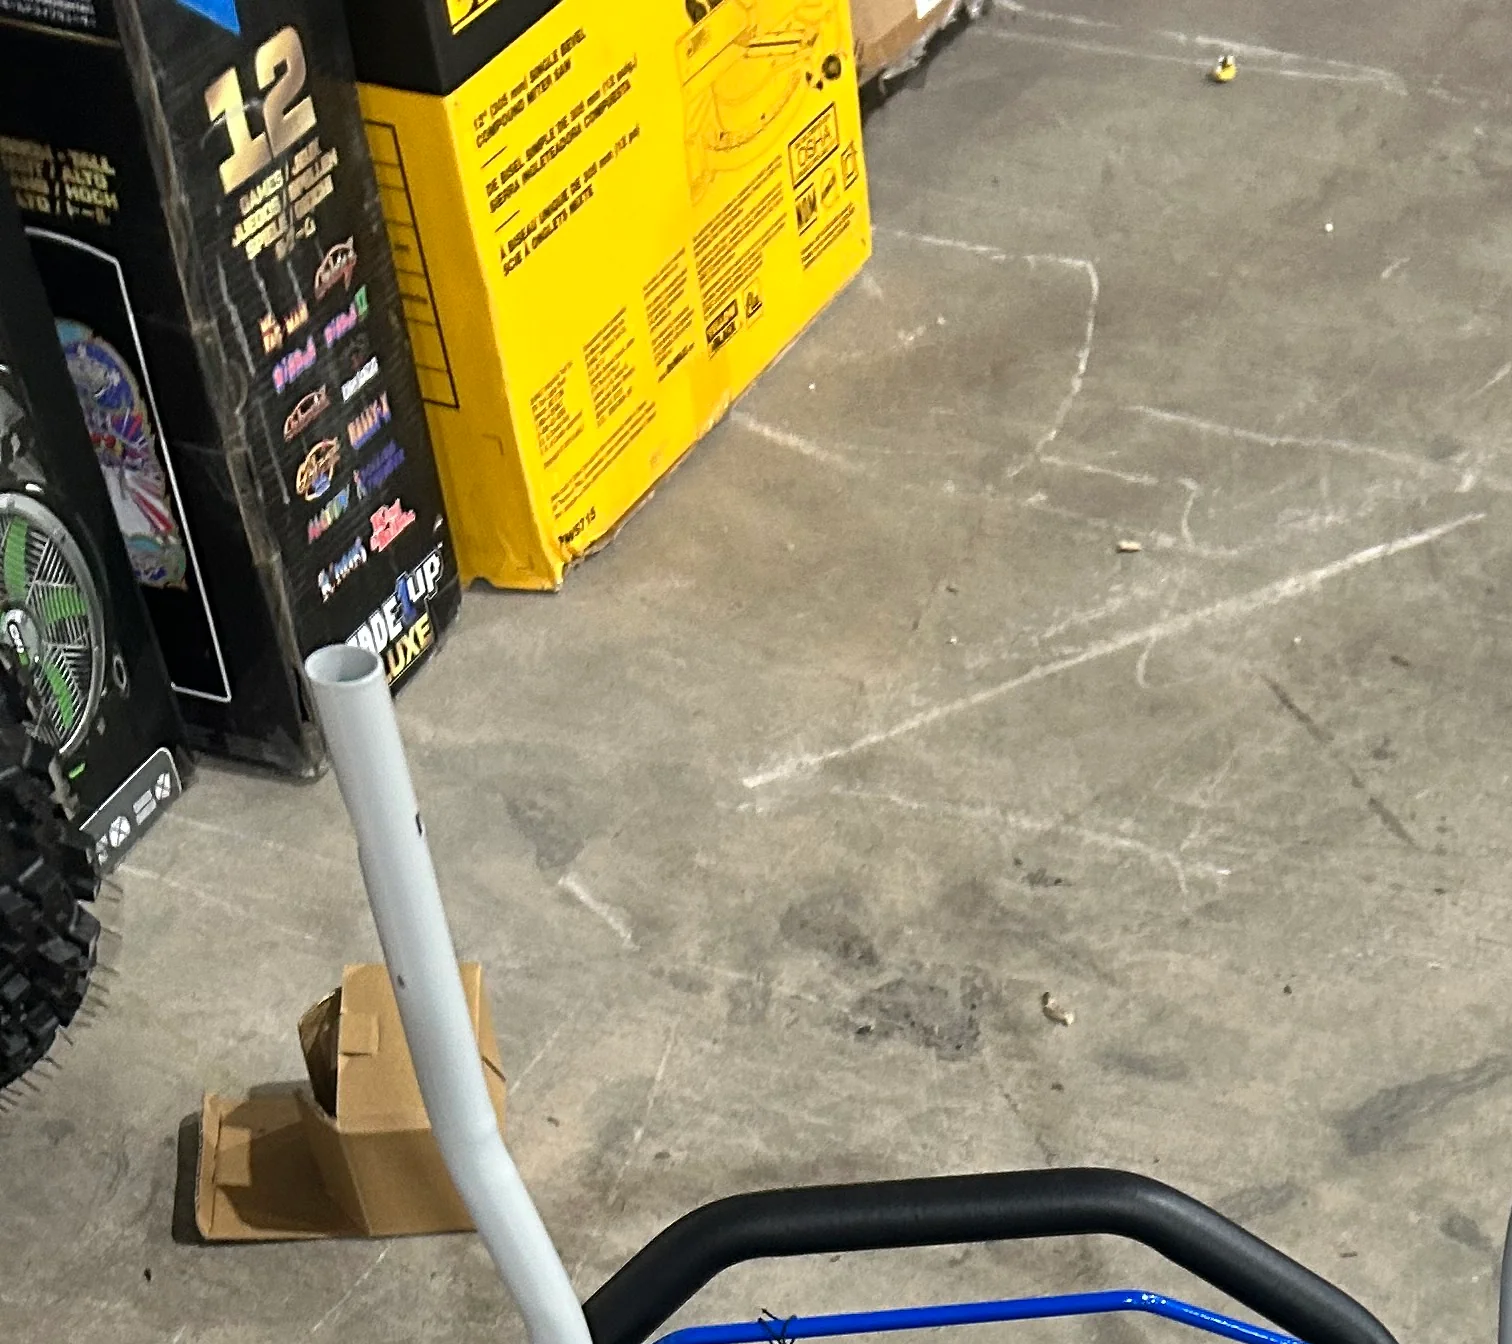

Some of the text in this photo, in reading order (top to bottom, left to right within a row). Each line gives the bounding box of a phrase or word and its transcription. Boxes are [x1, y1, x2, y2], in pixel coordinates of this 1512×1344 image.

[204, 25, 317, 196] 12
[346, 552, 442, 654] ADE1UP
[388, 612, 433, 683] UXE
